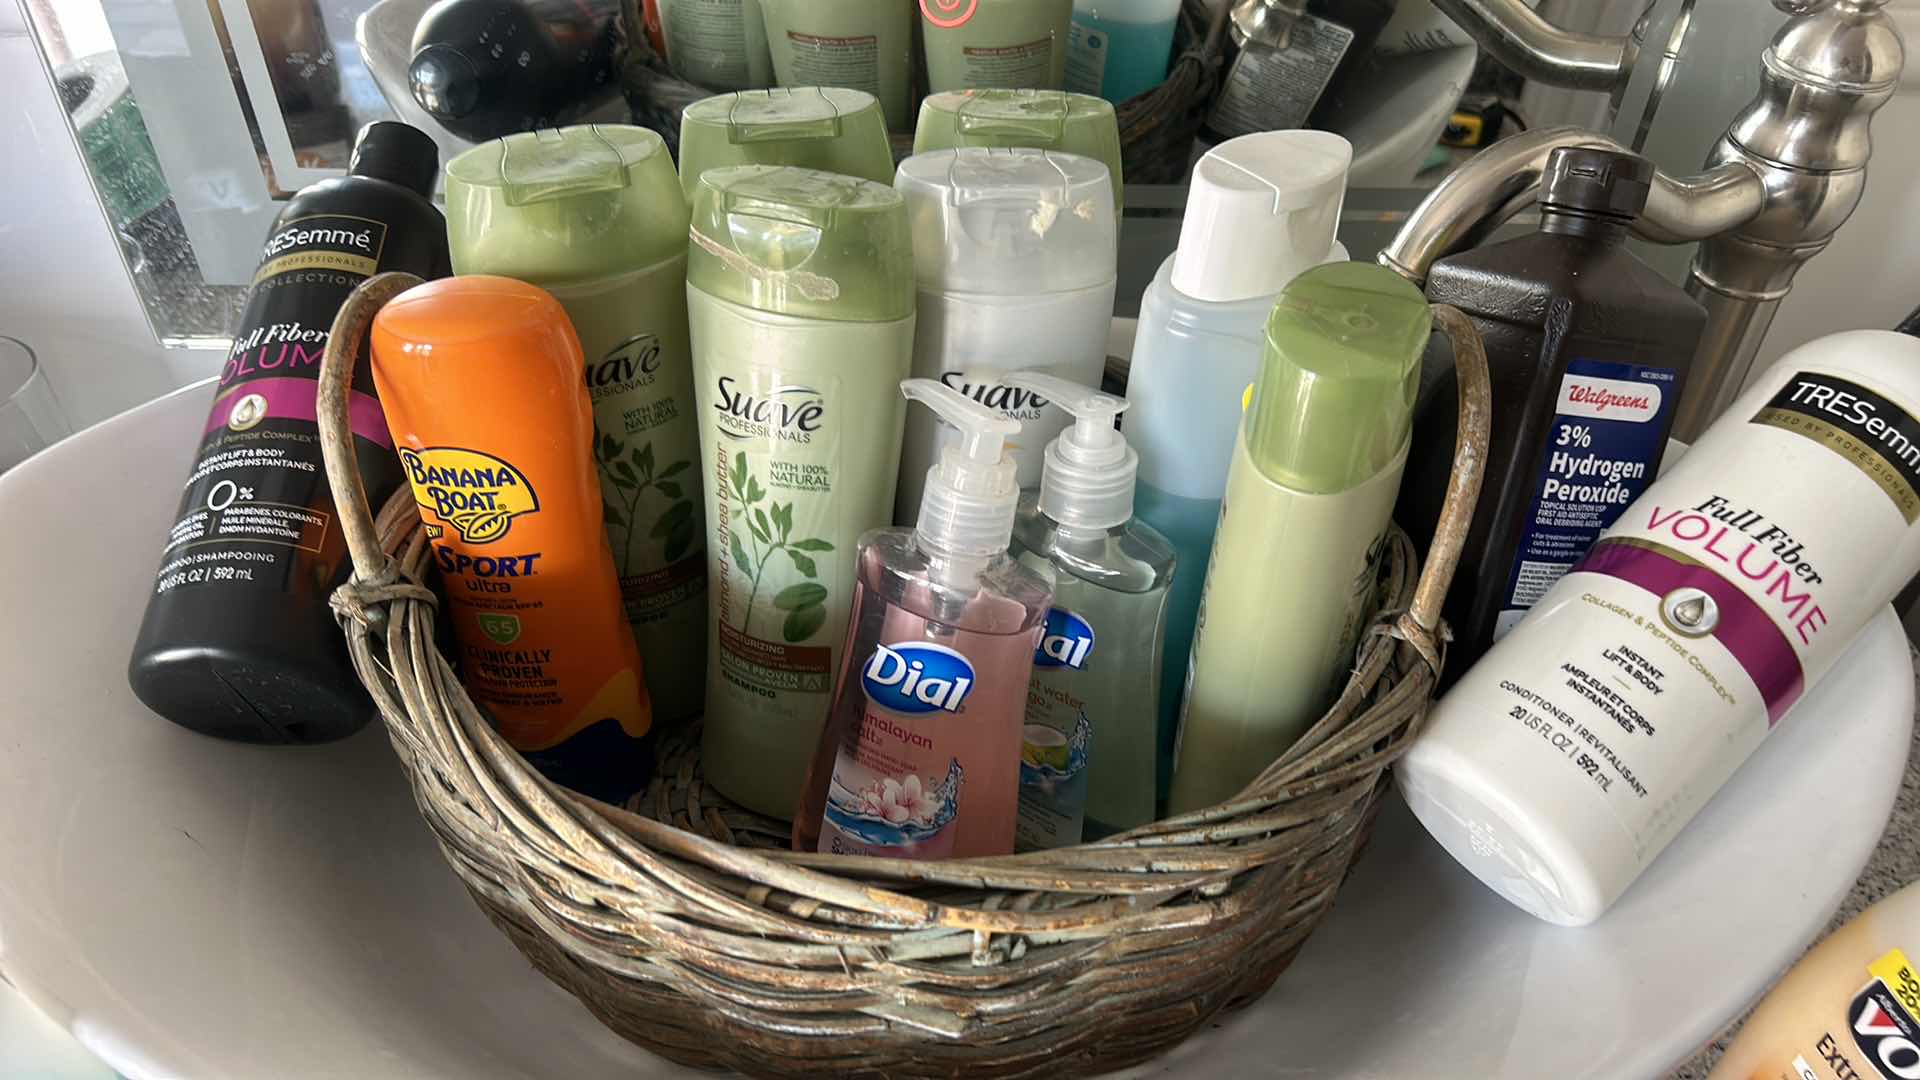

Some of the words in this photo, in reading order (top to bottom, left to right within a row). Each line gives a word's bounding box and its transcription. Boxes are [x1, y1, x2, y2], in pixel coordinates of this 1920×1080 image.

[263, 229, 372, 261] RESemmé
[261, 322, 330, 346] Fiber
[220, 343, 325, 386] OLUM
[586, 345, 661, 388] ave
[591, 374, 656, 397] ESSIONALS
[940, 371, 1050, 412] Suave
[1568, 384, 1649, 411] Walgreens
[714, 376, 823, 432] Suave
[719, 411, 811, 444] PROFESSIONALS
[1555, 423, 1592, 448] 3%
[1790, 381, 1920, 476] TRESemm
[255, 448, 286, 458] BODY
[403, 451, 517, 488] BANANA
[769, 460, 798, 472] WITH
[801, 463, 829, 475] 100%
[1549, 451, 1646, 482] Hydrogen
[1804, 421, 1822, 433] BY
[1825, 431, 1914, 510] PROFESSIONALS
[717, 442, 729, 504] butter
[769, 469, 831, 487] NATURAL
[1539, 500, 1566, 511] TOPICAL
[1541, 477, 1630, 504] Peroxide
[717, 506, 729, 544] shea
[1535, 516, 1553, 526] ORAL
[1537, 508, 1557, 518] FIRST
[1567, 511, 1600, 520] ANTISEPTIC
[424, 525, 443, 539] EW!
[1692, 494, 1764, 533] Full
[1751, 523, 1823, 587] Fiber
[195, 551, 276, 564] SHAMPOOING
[212, 566, 234, 580] 592
[235, 568, 254, 581] mL
[436, 546, 542, 578] SPORT
[464, 579, 512, 593] ultra
[1646, 506, 1828, 645] VOLUME
[1581, 592, 1633, 620] COLLAGEN
[1633, 615, 1645, 627] &
[1644, 621, 1690, 660] PEPTIDE
[1036, 619, 1092, 669] ial
[866, 643, 972, 712] Dial
[1602, 648, 1629, 671] LIFT
[1624, 663, 1634, 674] &
[1632, 671, 1664, 697] BODY
[1618, 645, 1665, 681] INSTANT
[721, 669, 777, 699] SHAMPOO
[1043, 685, 1085, 711] water
[1560, 662, 1612, 699] AMPLEUR
[1608, 692, 1625, 706] ET
[1622, 702, 1656, 737] CORPS
[1565, 678, 1637, 735] INSTANTANÉS
[856, 724, 878, 743] alt
[862, 711, 933, 750] malayan
[1499, 680, 1575, 728] CONDITIONER
[1579, 728, 1648, 799] REVITALISANT
[1509, 705, 1528, 720] 20
[1523, 713, 1543, 730] US
[1538, 722, 1553, 740] FL
[1551, 731, 1573, 753] OZ
[1576, 753, 1600, 777] 592
[1594, 772, 1614, 794] mL
[1815, 1031, 1864, 1080] Extr
